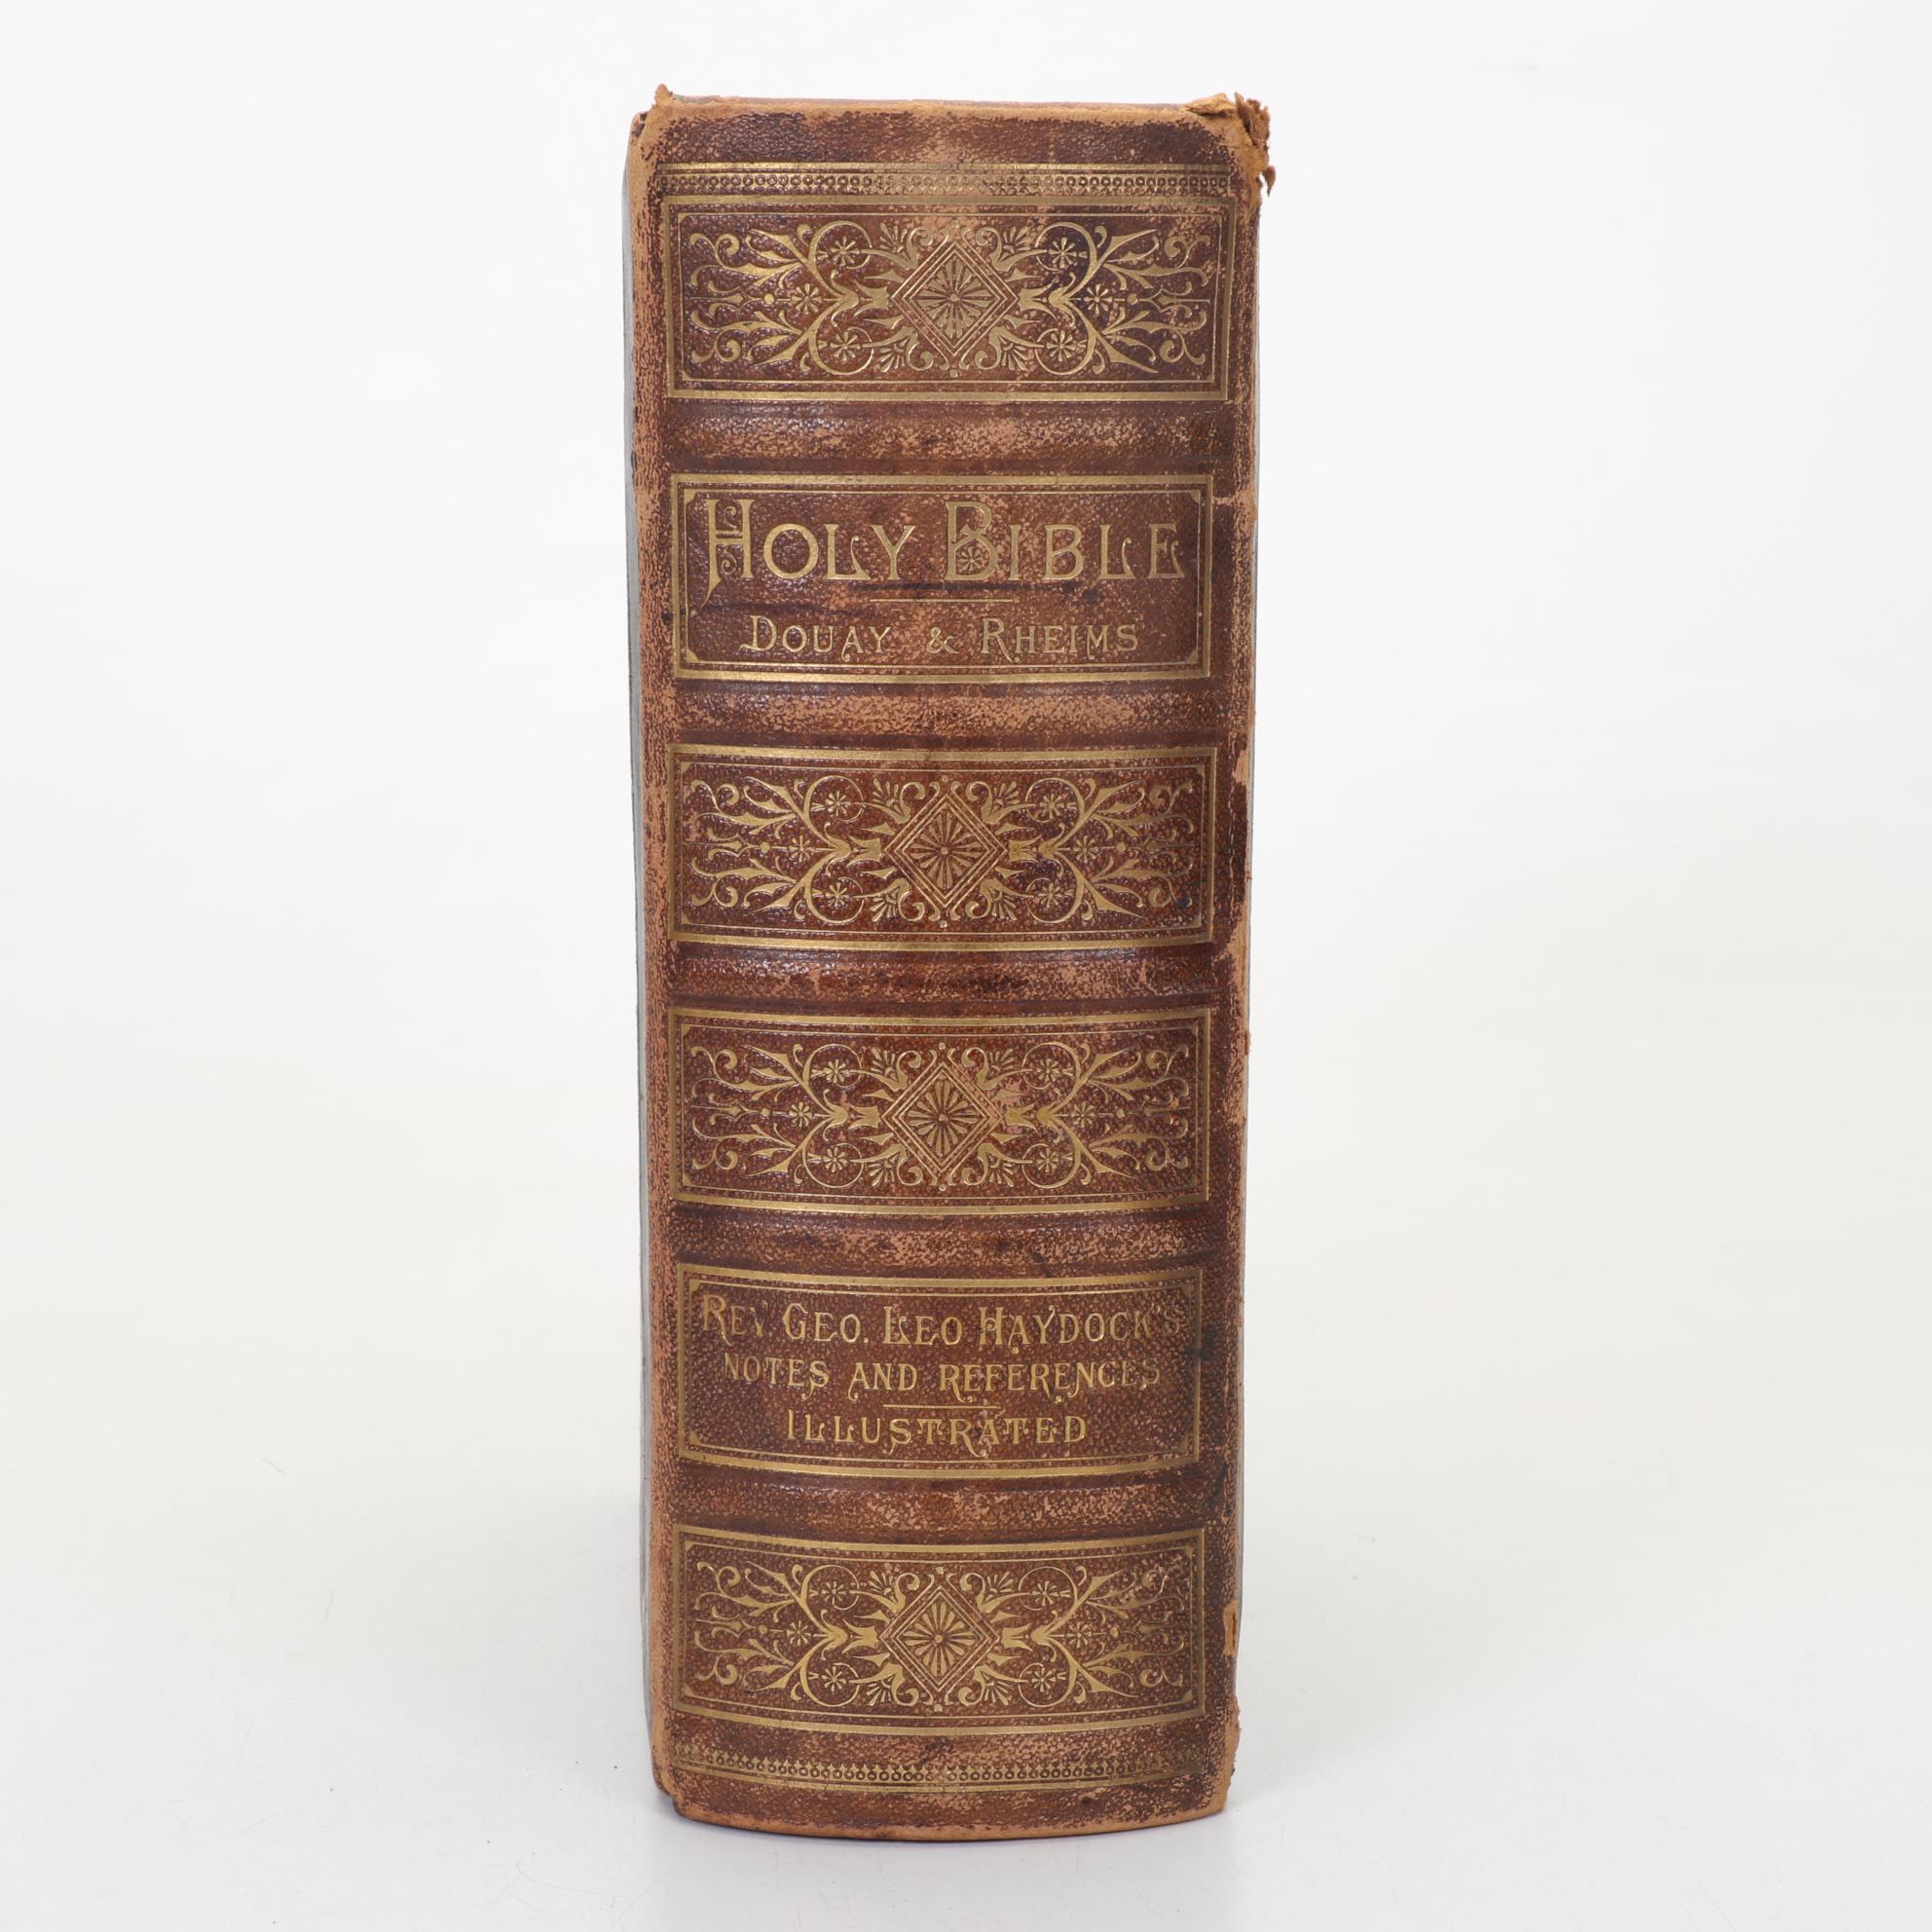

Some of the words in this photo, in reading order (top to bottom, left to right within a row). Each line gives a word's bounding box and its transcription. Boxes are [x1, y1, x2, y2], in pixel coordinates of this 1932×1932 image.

[690, 499, 916, 615] HOLY
[944, 501, 1185, 581] BIBLE
[739, 614, 892, 662] DOUAY
[926, 626, 958, 654] &
[981, 617, 1138, 662] RHEIMS
[782, 1302, 870, 1344] GEO.
[882, 1305, 963, 1346] LEO
[978, 1303, 1181, 1355] HAYDOCK'S
[724, 1352, 830, 1400] NOTES
[847, 1361, 918, 1401] AND
[939, 1359, 1162, 1403] REFERENCES
[787, 1408, 1087, 1458] ILLUSTRATED
